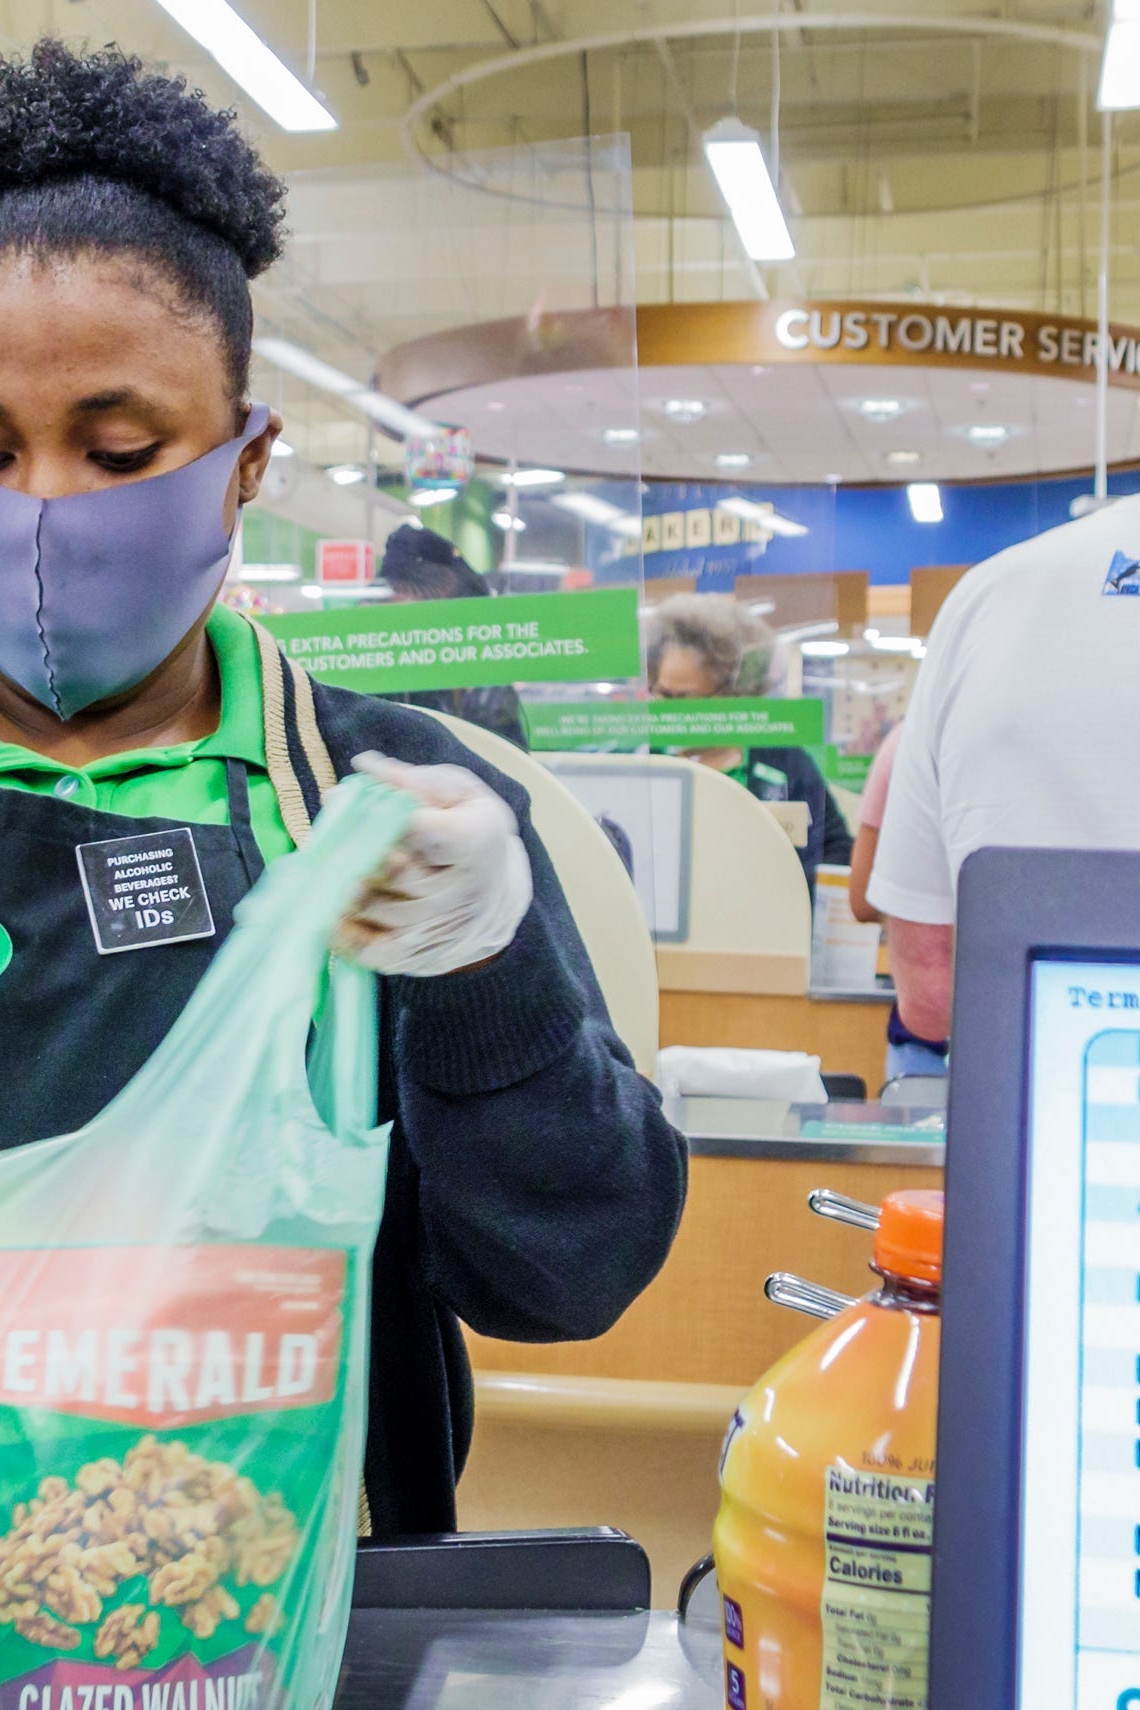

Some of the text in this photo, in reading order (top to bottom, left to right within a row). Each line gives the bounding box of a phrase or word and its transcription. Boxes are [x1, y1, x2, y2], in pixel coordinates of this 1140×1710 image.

[774, 308, 1140, 374] CUSTOMER SERVI
[290, 635, 343, 654] EXTRA
[347, 628, 463, 650] PRECAUTIONS
[467, 625, 503, 641] FOR
[506, 621, 540, 639] THE
[398, 646, 436, 666] AND
[440, 645, 478, 664] OUR
[481, 638, 589, 660] ASSOCIATES.
[661, 711, 726, 722] PRECAUTIONS
[728, 711, 749, 722] FOR
[750, 710, 769, 721] THE
[630, 723, 688, 735] CUSTOMERS
[689, 723, 711, 734] AND
[713, 723, 734, 733] OUR
[106, 847, 174, 867] PURCHASING
[114, 861, 174, 880] ALCOHOLIC
[113, 874, 179, 894] BEVERAGES?
[108, 886, 191, 912] WE CHECK
[134, 908, 175, 930] IDs
[2, 1329, 320, 1414] EMERALD
[828, 1516, 867, 1535] Serving
[868, 1523, 890, 1536] size
[829, 1555, 904, 1584] Calories
[825, 1603, 847, 1617] Total
[849, 1608, 865, 1621] Fat
[825, 1681, 847, 1695] Total
